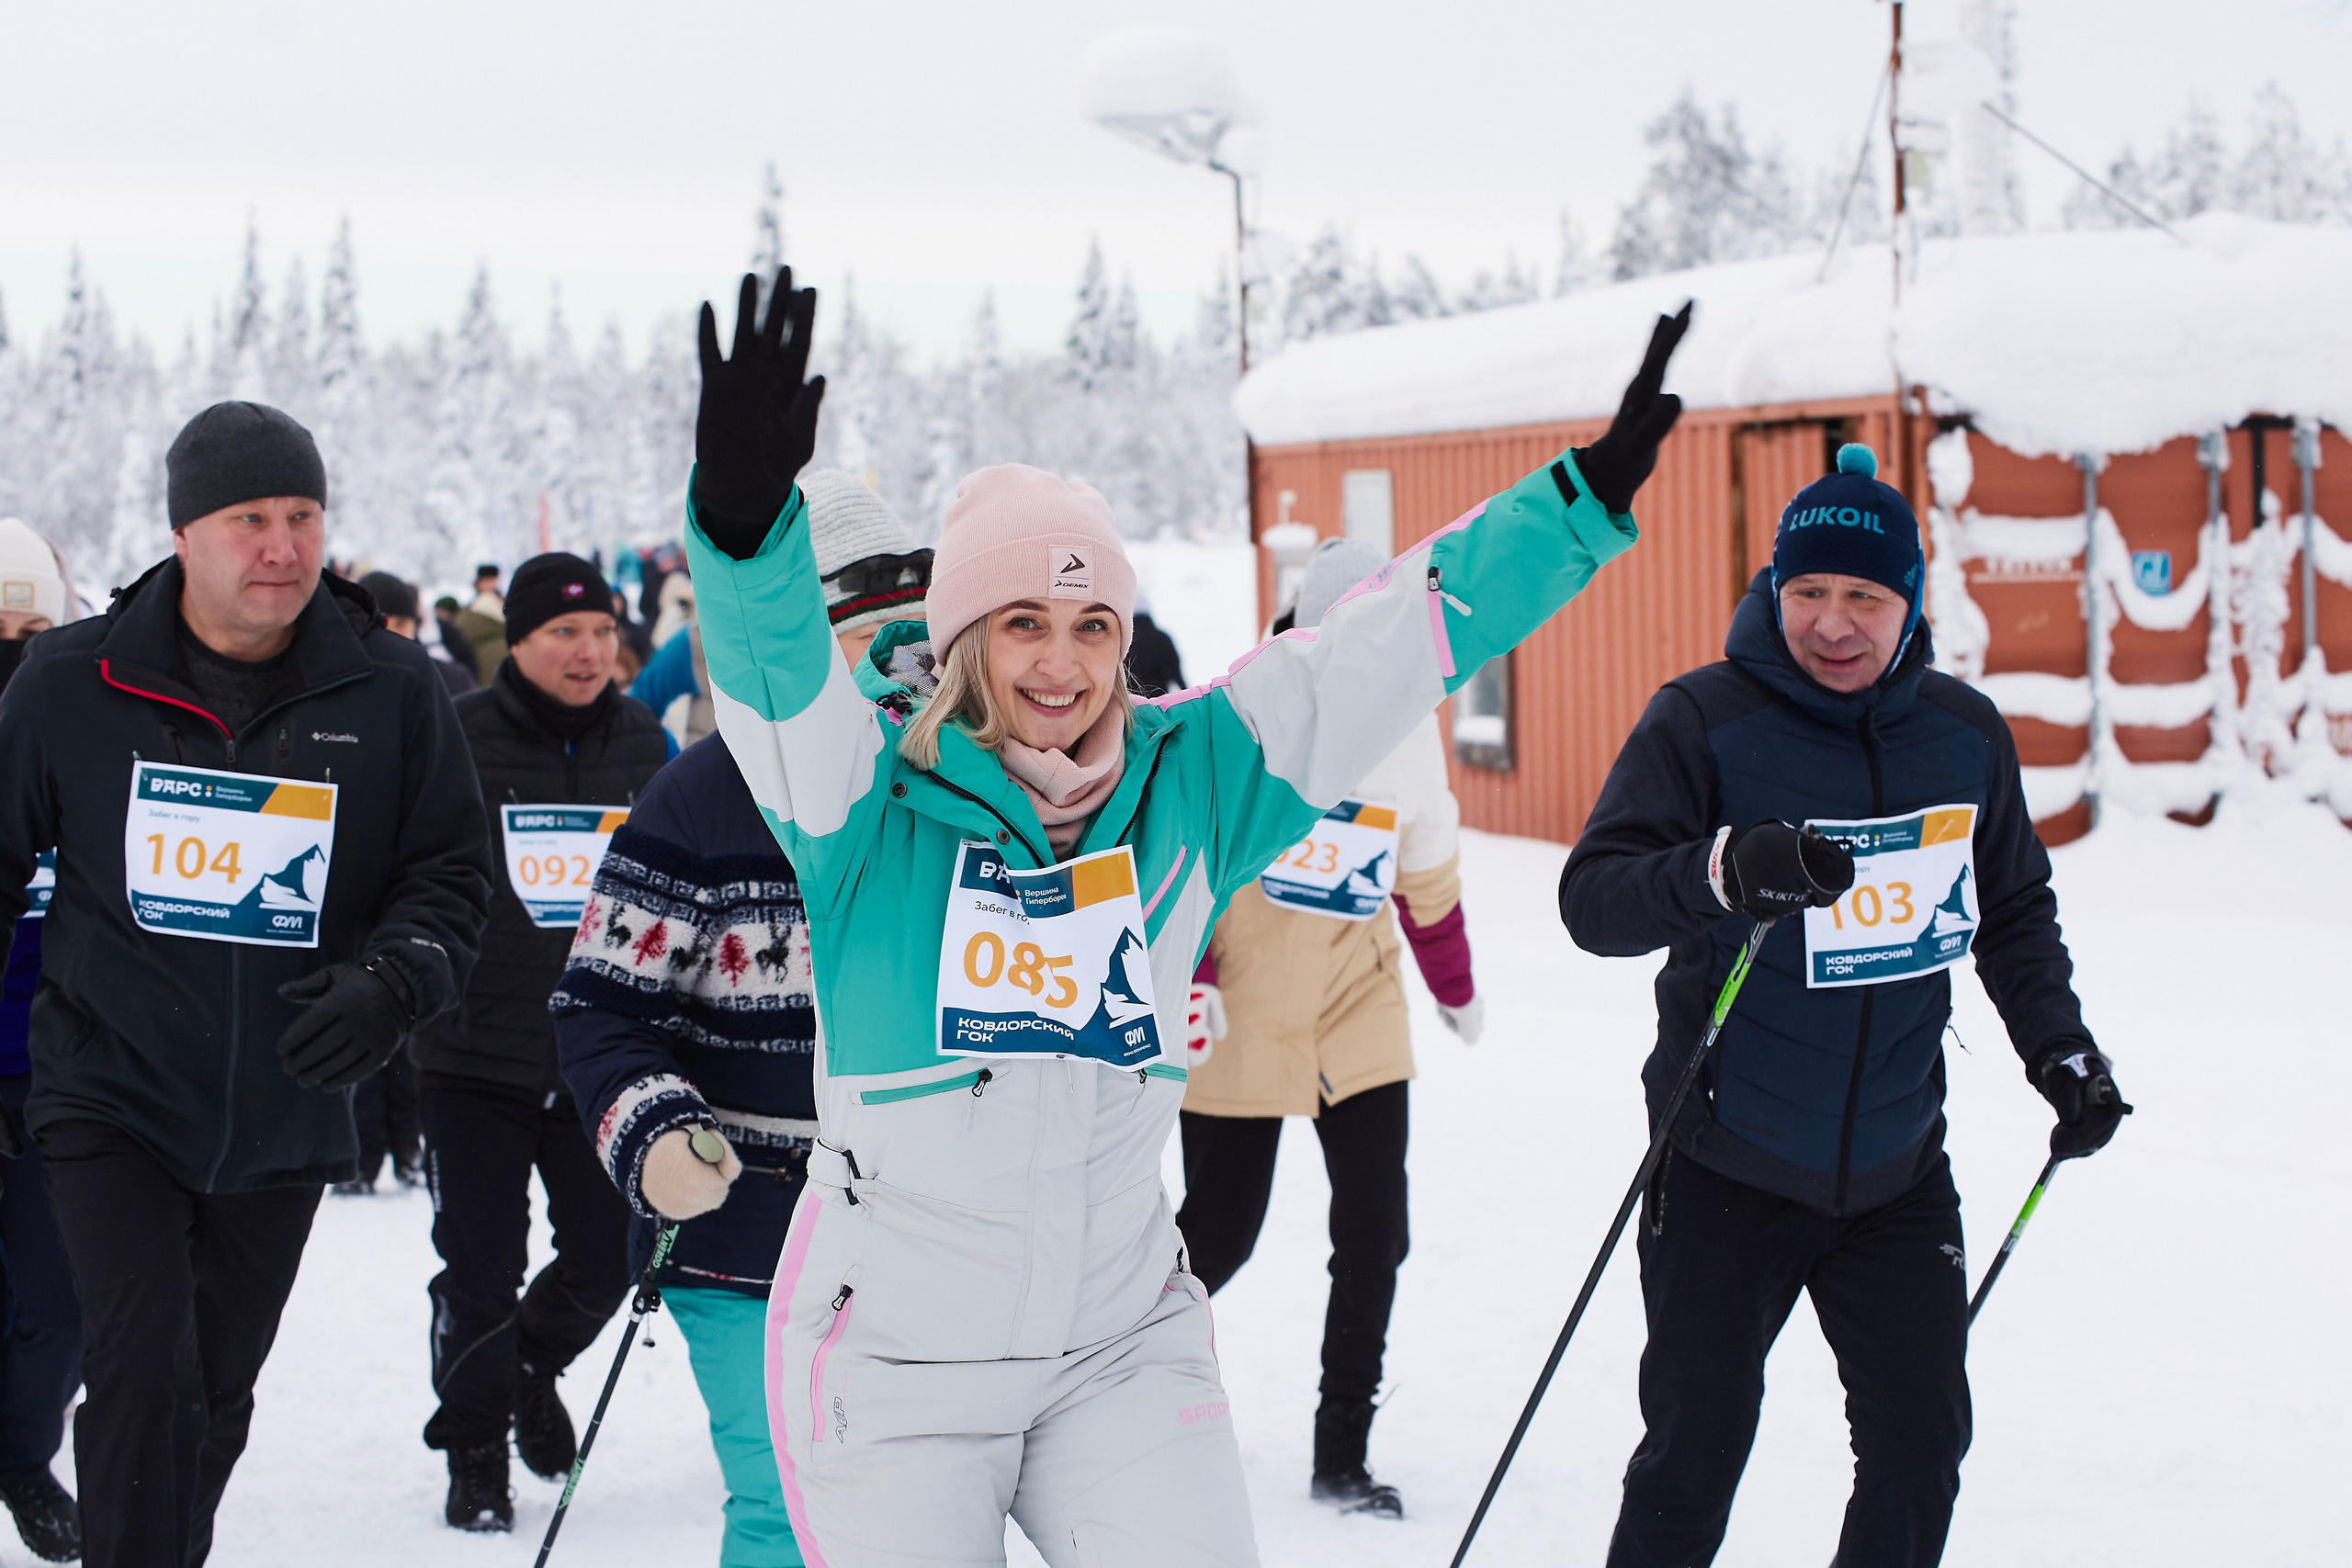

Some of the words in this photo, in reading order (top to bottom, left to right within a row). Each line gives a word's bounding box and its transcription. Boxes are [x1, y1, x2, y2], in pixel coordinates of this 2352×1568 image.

[1789, 507, 1885, 535] LUKOIL
[146, 833, 243, 885] 104
[519, 854, 592, 886] 092
[1024, 886, 1059, 897] Вершина
[139, 898, 231, 919] КОВДОРСКИЙ
[139, 908, 164, 921] ГОК
[974, 901, 1008, 916] Забег
[1830, 882, 1915, 930] 103
[1826, 946, 1914, 966] КОВДОРСКИЙ
[963, 931, 1079, 1010] 085
[1826, 964, 1855, 976] ГОК
[956, 1030, 994, 1043] ГОК
[957, 1017, 1076, 1042] КОВДОРСКИЙ
